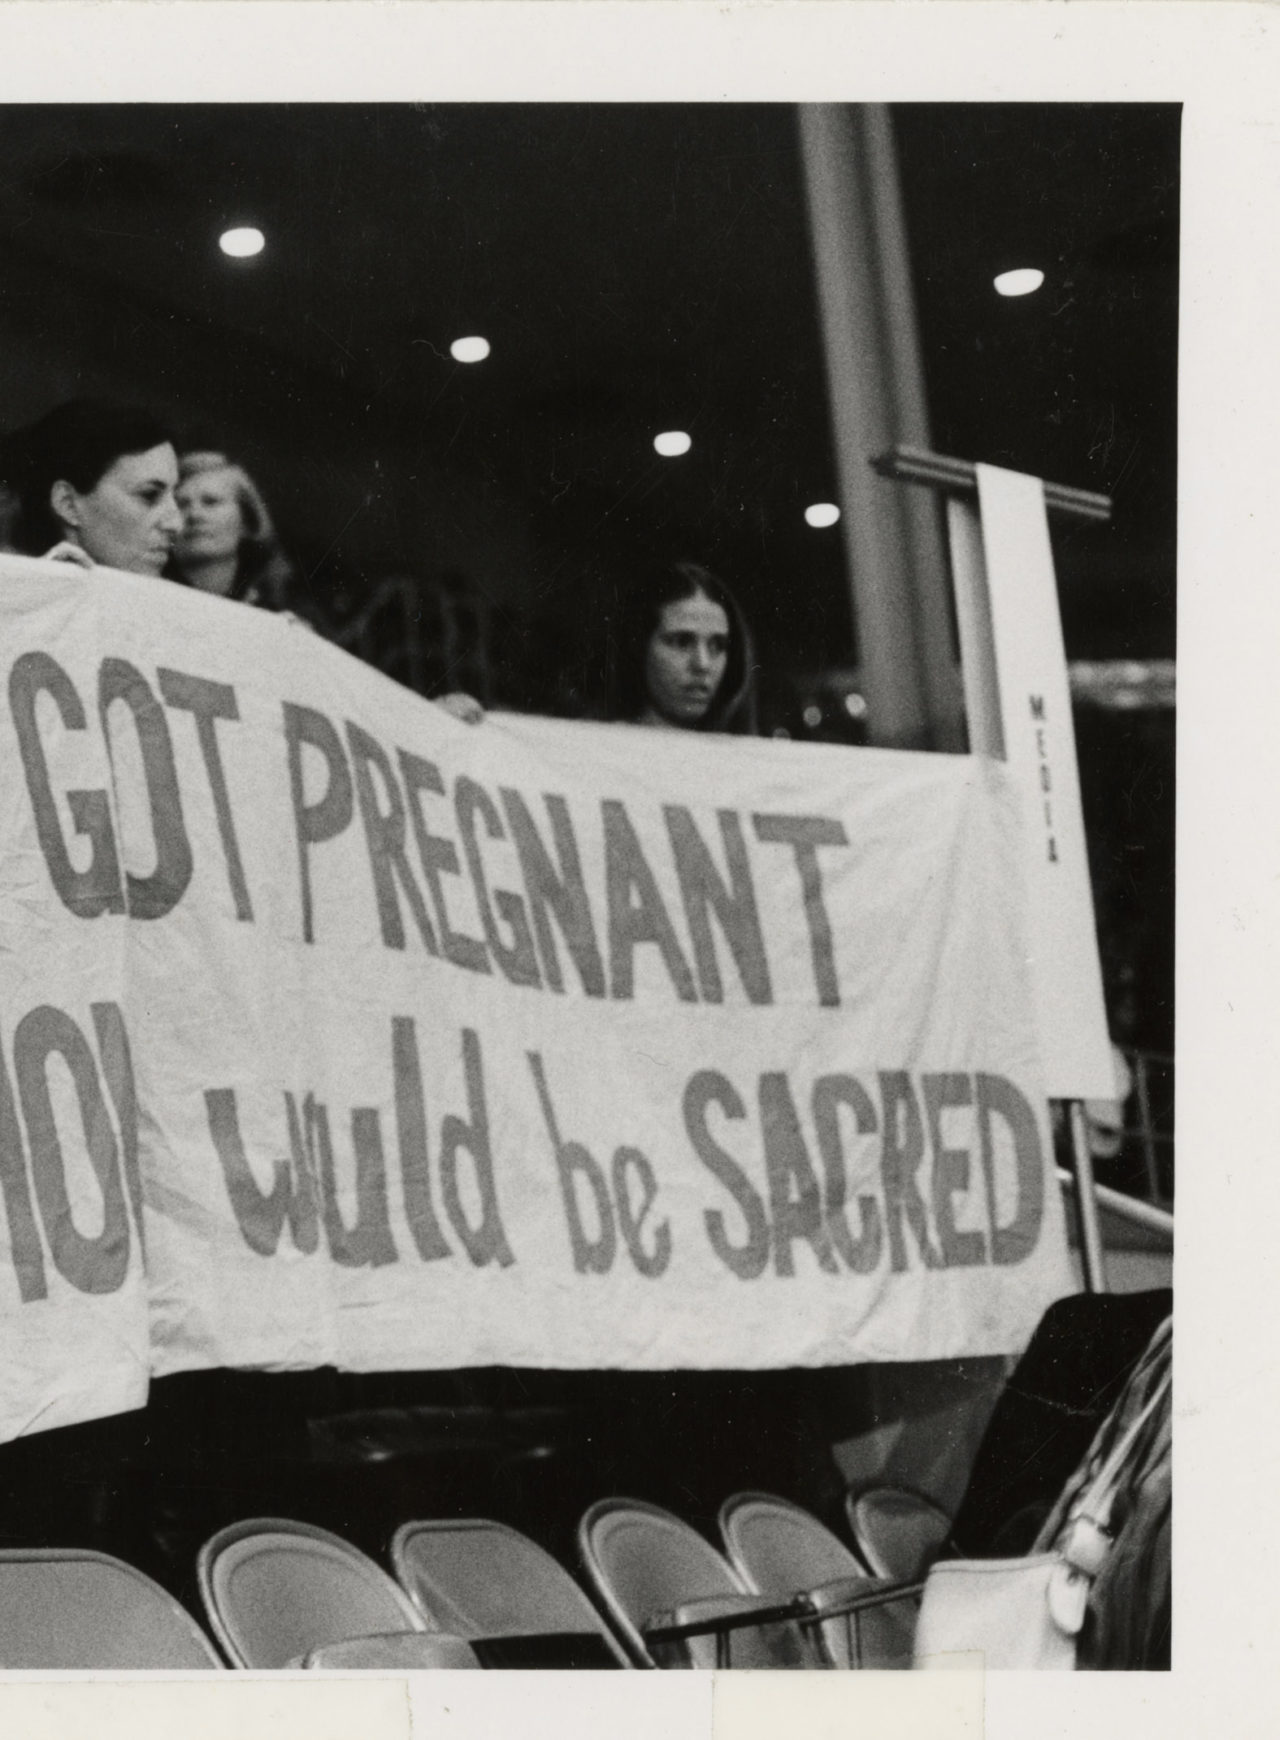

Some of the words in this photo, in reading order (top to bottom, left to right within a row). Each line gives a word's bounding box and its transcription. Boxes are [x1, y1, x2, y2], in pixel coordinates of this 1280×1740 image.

[8, 651, 253, 921] GOT
[283, 700, 849, 1008] PREGNANT
[525, 1050, 672, 1278] be
[682, 1069, 1045, 1280] SACRED
